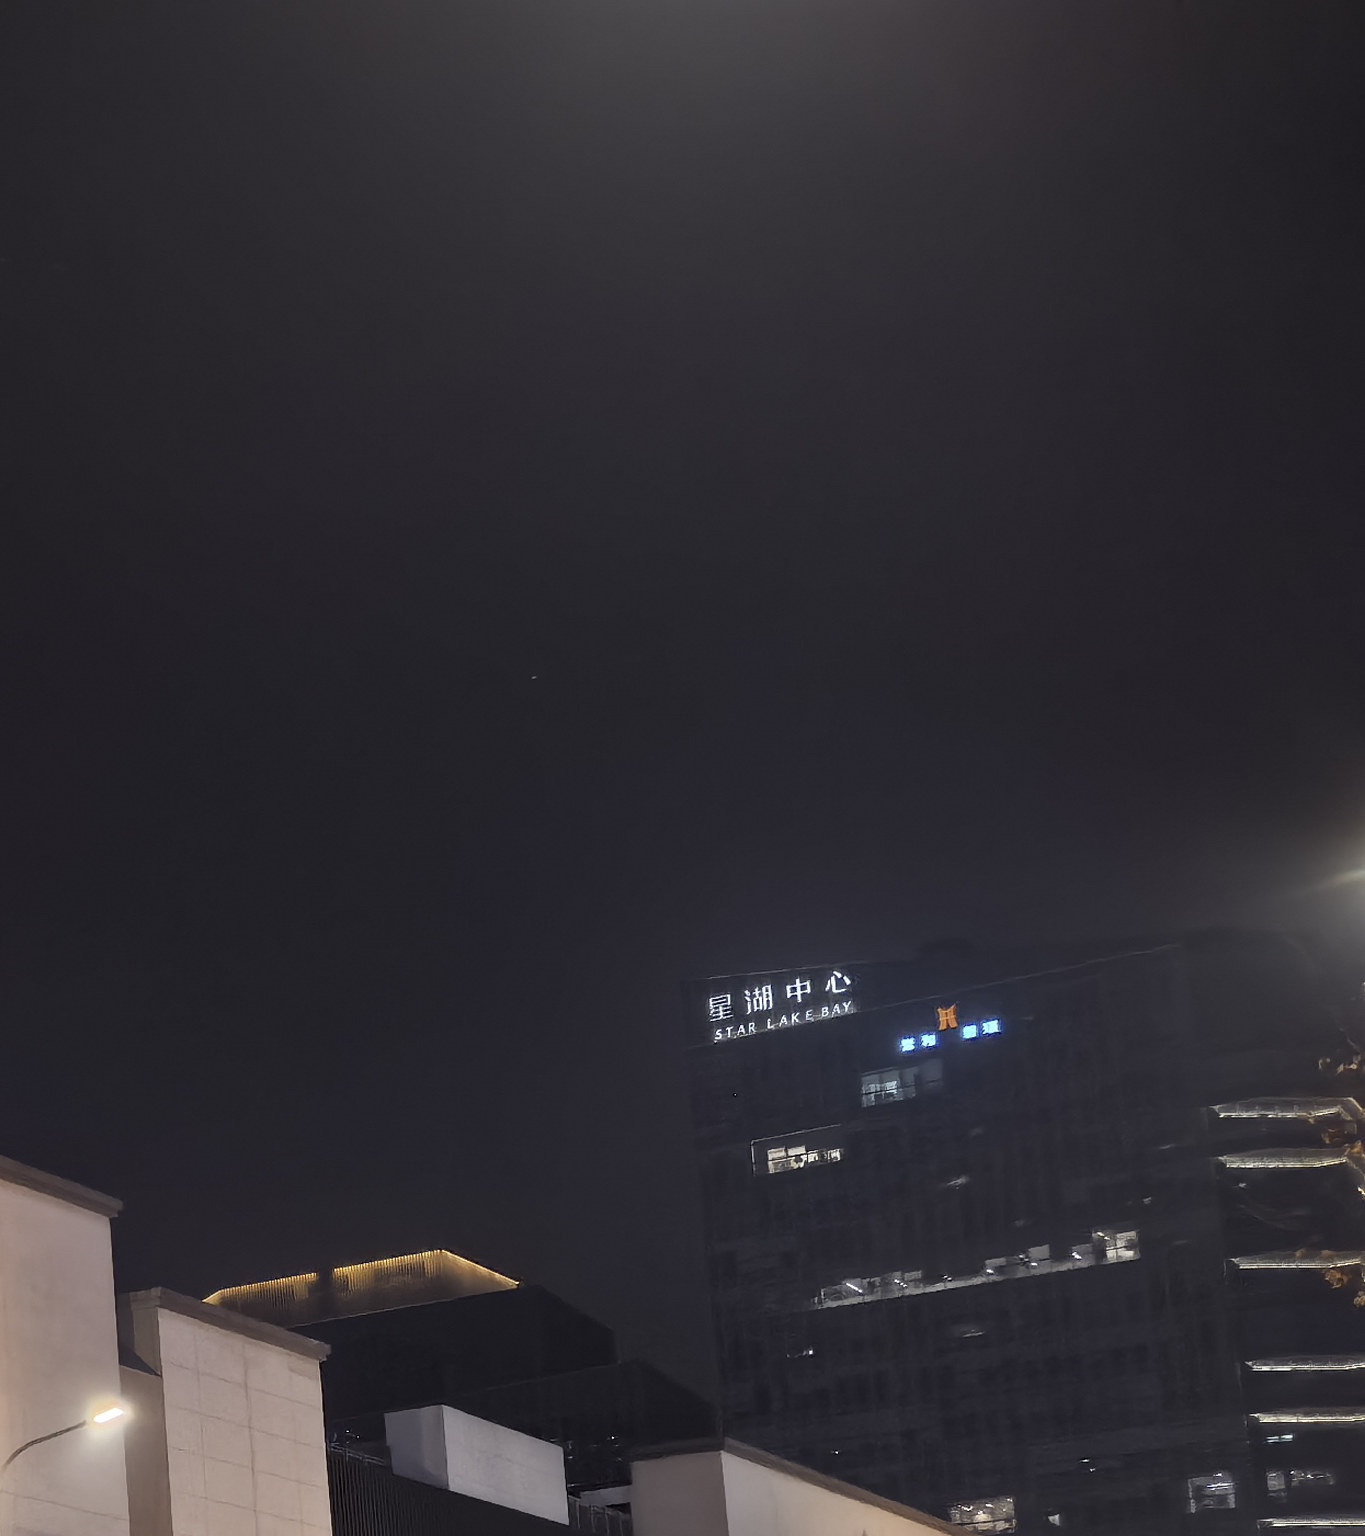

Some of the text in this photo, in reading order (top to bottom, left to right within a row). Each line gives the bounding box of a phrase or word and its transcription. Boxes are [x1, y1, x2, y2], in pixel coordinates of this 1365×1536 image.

[709, 970, 852, 1022] 星湖中心
[714, 1000, 852, 1041] STAR LAKE BAY
